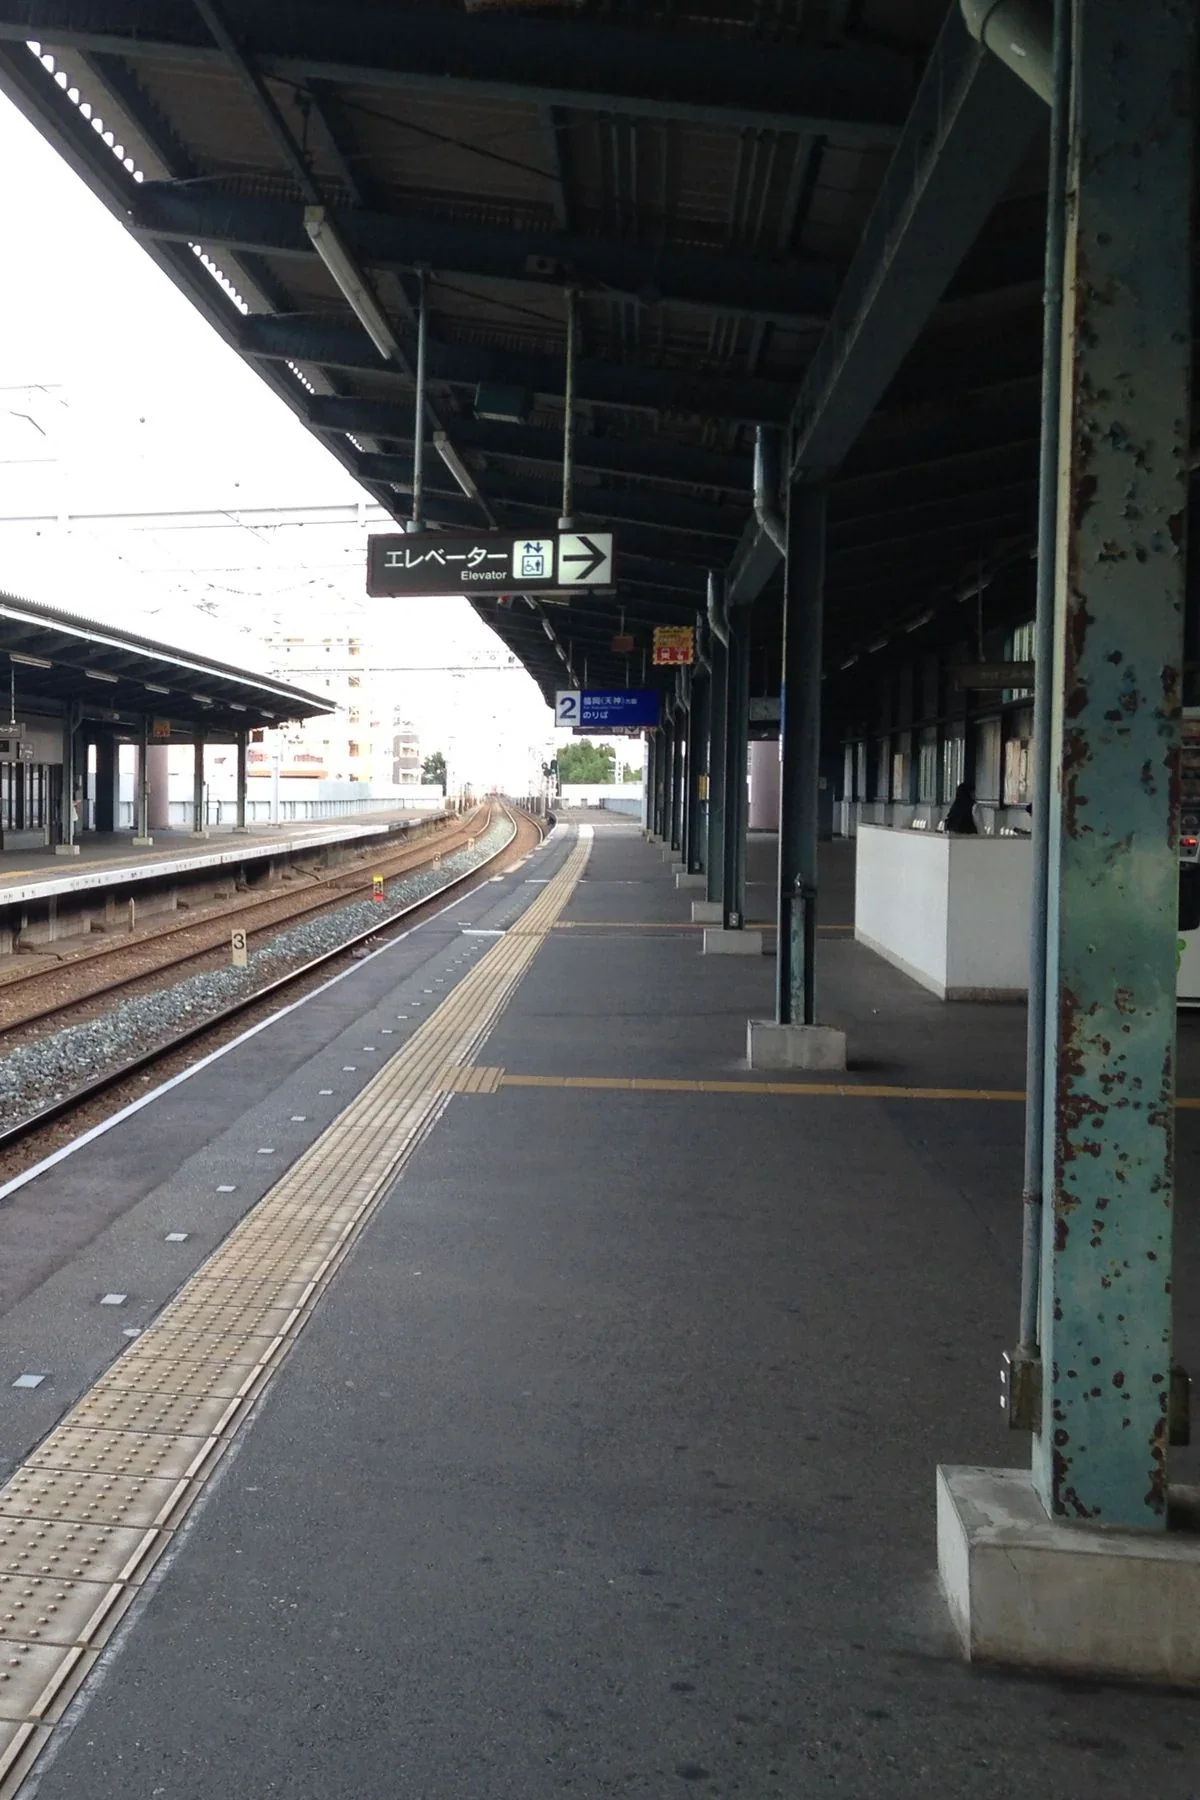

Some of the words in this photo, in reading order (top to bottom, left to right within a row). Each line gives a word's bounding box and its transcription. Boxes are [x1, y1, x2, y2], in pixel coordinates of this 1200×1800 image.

[384, 546, 508, 568] エレベーター
[460, 570, 508, 580] Elevator
[560, 697, 577, 719] 2
[582, 711, 609, 719] のりば
[233, 933, 245, 950] 3
